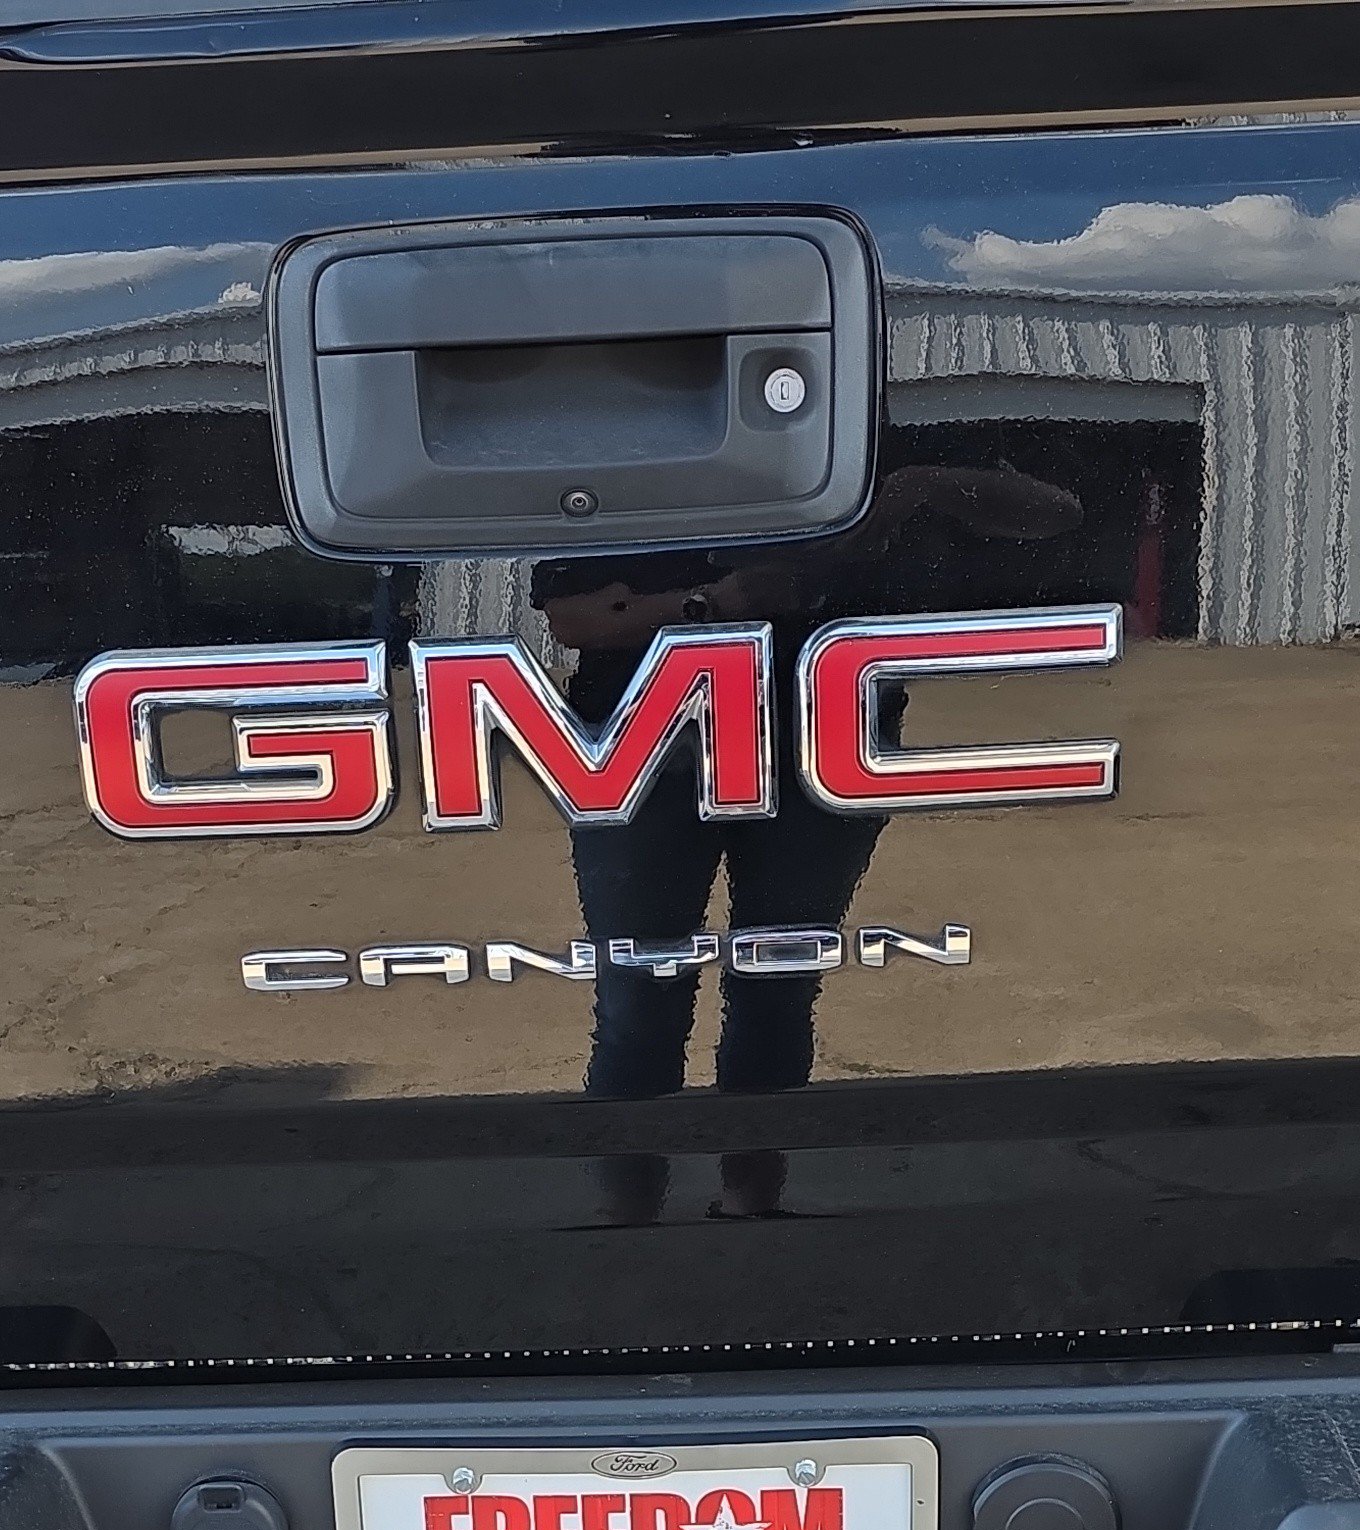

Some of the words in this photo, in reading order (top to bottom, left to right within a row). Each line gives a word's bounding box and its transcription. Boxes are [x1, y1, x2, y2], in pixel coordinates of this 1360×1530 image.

[75, 602, 1123, 841] GMC
[241, 923, 973, 992] CANYON
[610, 1455, 660, 1472] Ford
